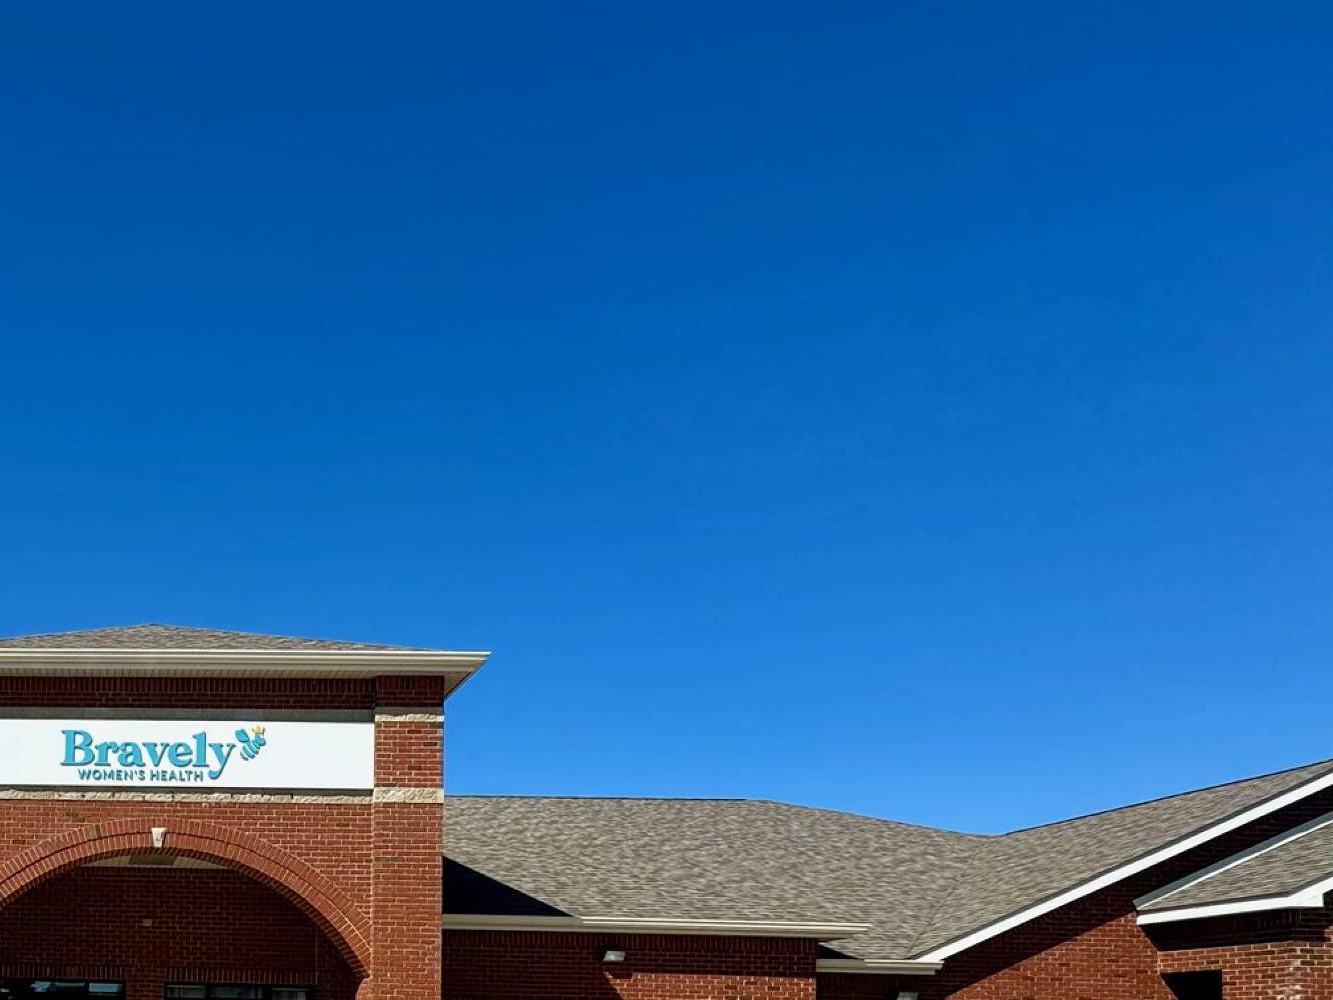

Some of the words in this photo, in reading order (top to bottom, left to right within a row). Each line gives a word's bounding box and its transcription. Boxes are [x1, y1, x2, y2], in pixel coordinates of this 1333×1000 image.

[60, 729, 236, 780] Bravely
[78, 769, 146, 781] WOMEN'S
[150, 770, 204, 782] HEALTH
